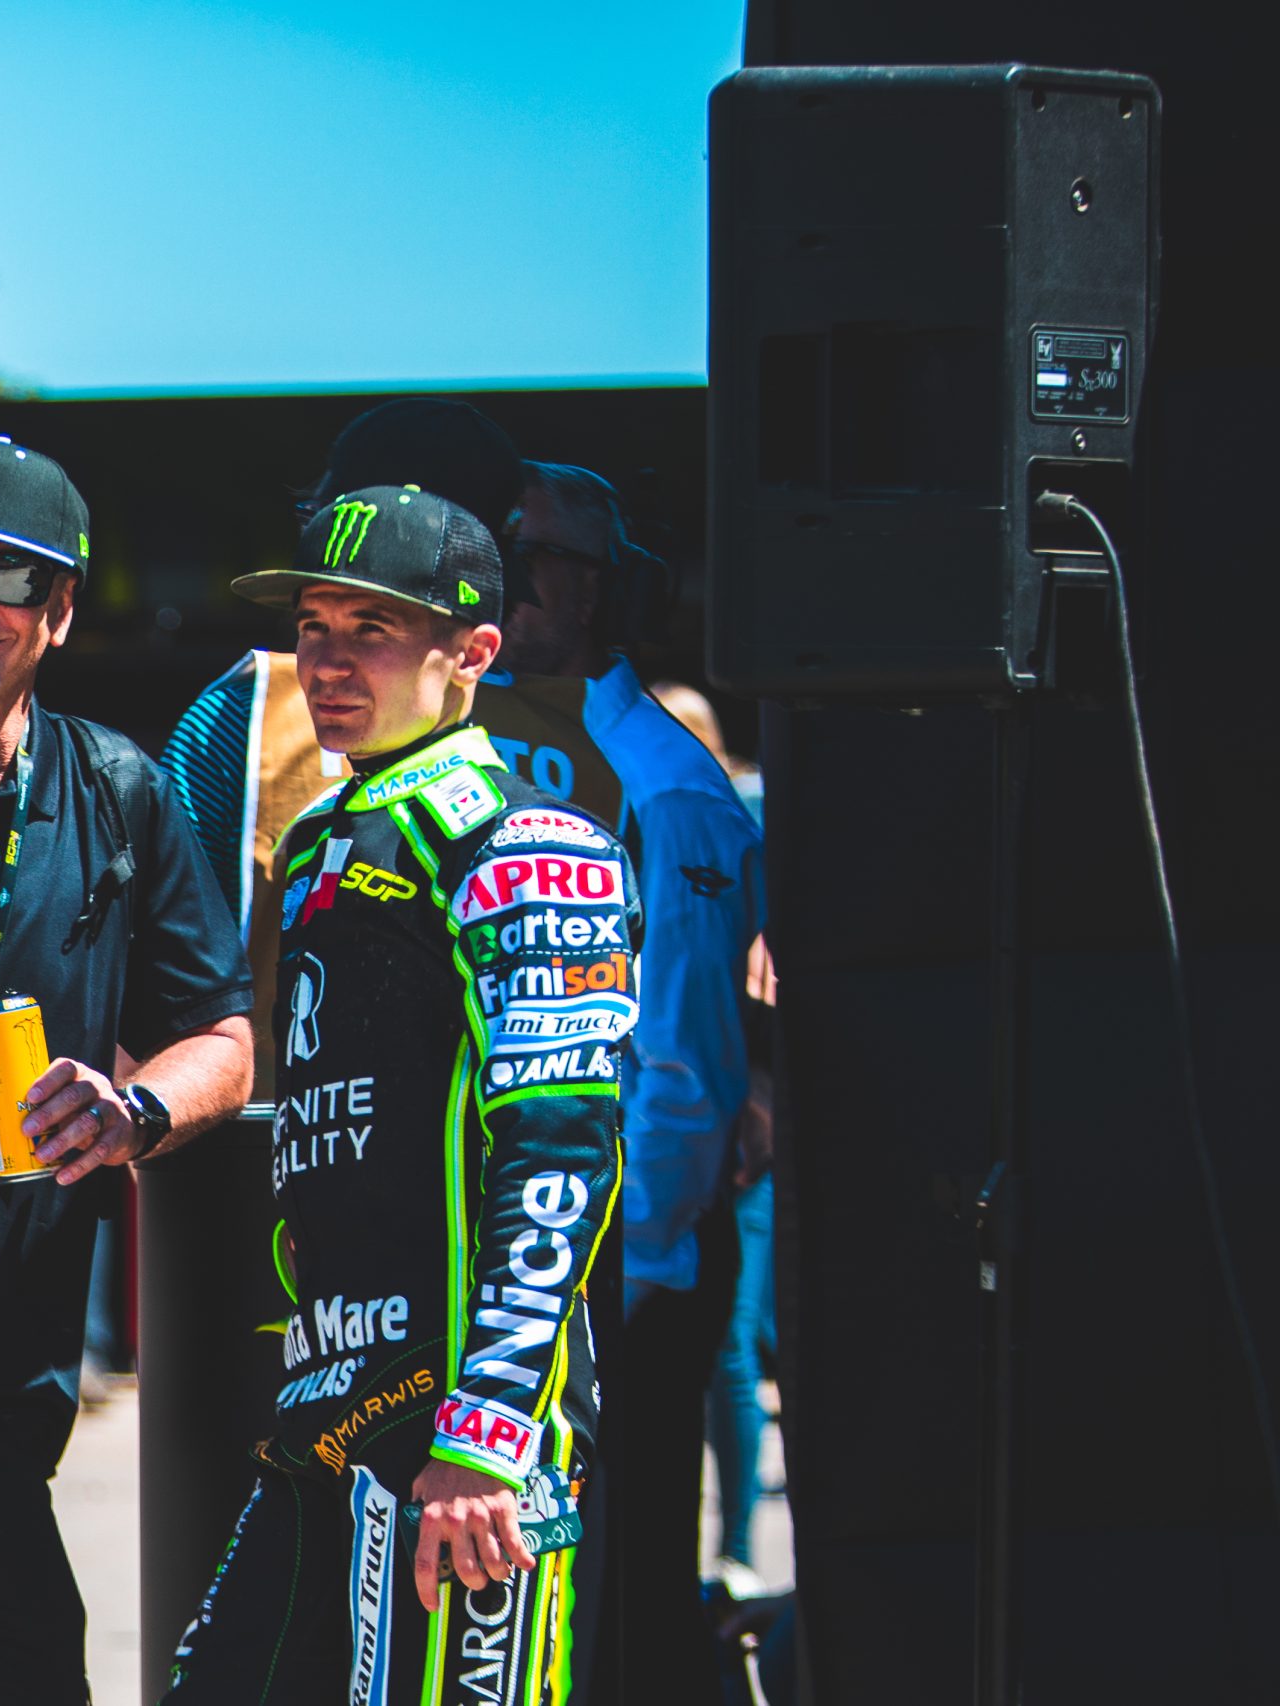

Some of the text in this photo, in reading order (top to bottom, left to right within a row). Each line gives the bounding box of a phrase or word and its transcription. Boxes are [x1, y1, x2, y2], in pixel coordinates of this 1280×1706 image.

[339, 862, 418, 902] SGP
[462, 858, 615, 919] APRO
[467, 908, 624, 965] Bartex
[496, 1013, 621, 1035] ami Truck
[519, 1046, 615, 1084] ANLAS
[463, 1170, 589, 1390] Nice
[314, 1295, 409, 1356] Mare
[334, 1369, 435, 1447] MARWIS
[360, 1498, 389, 1608] Truck
